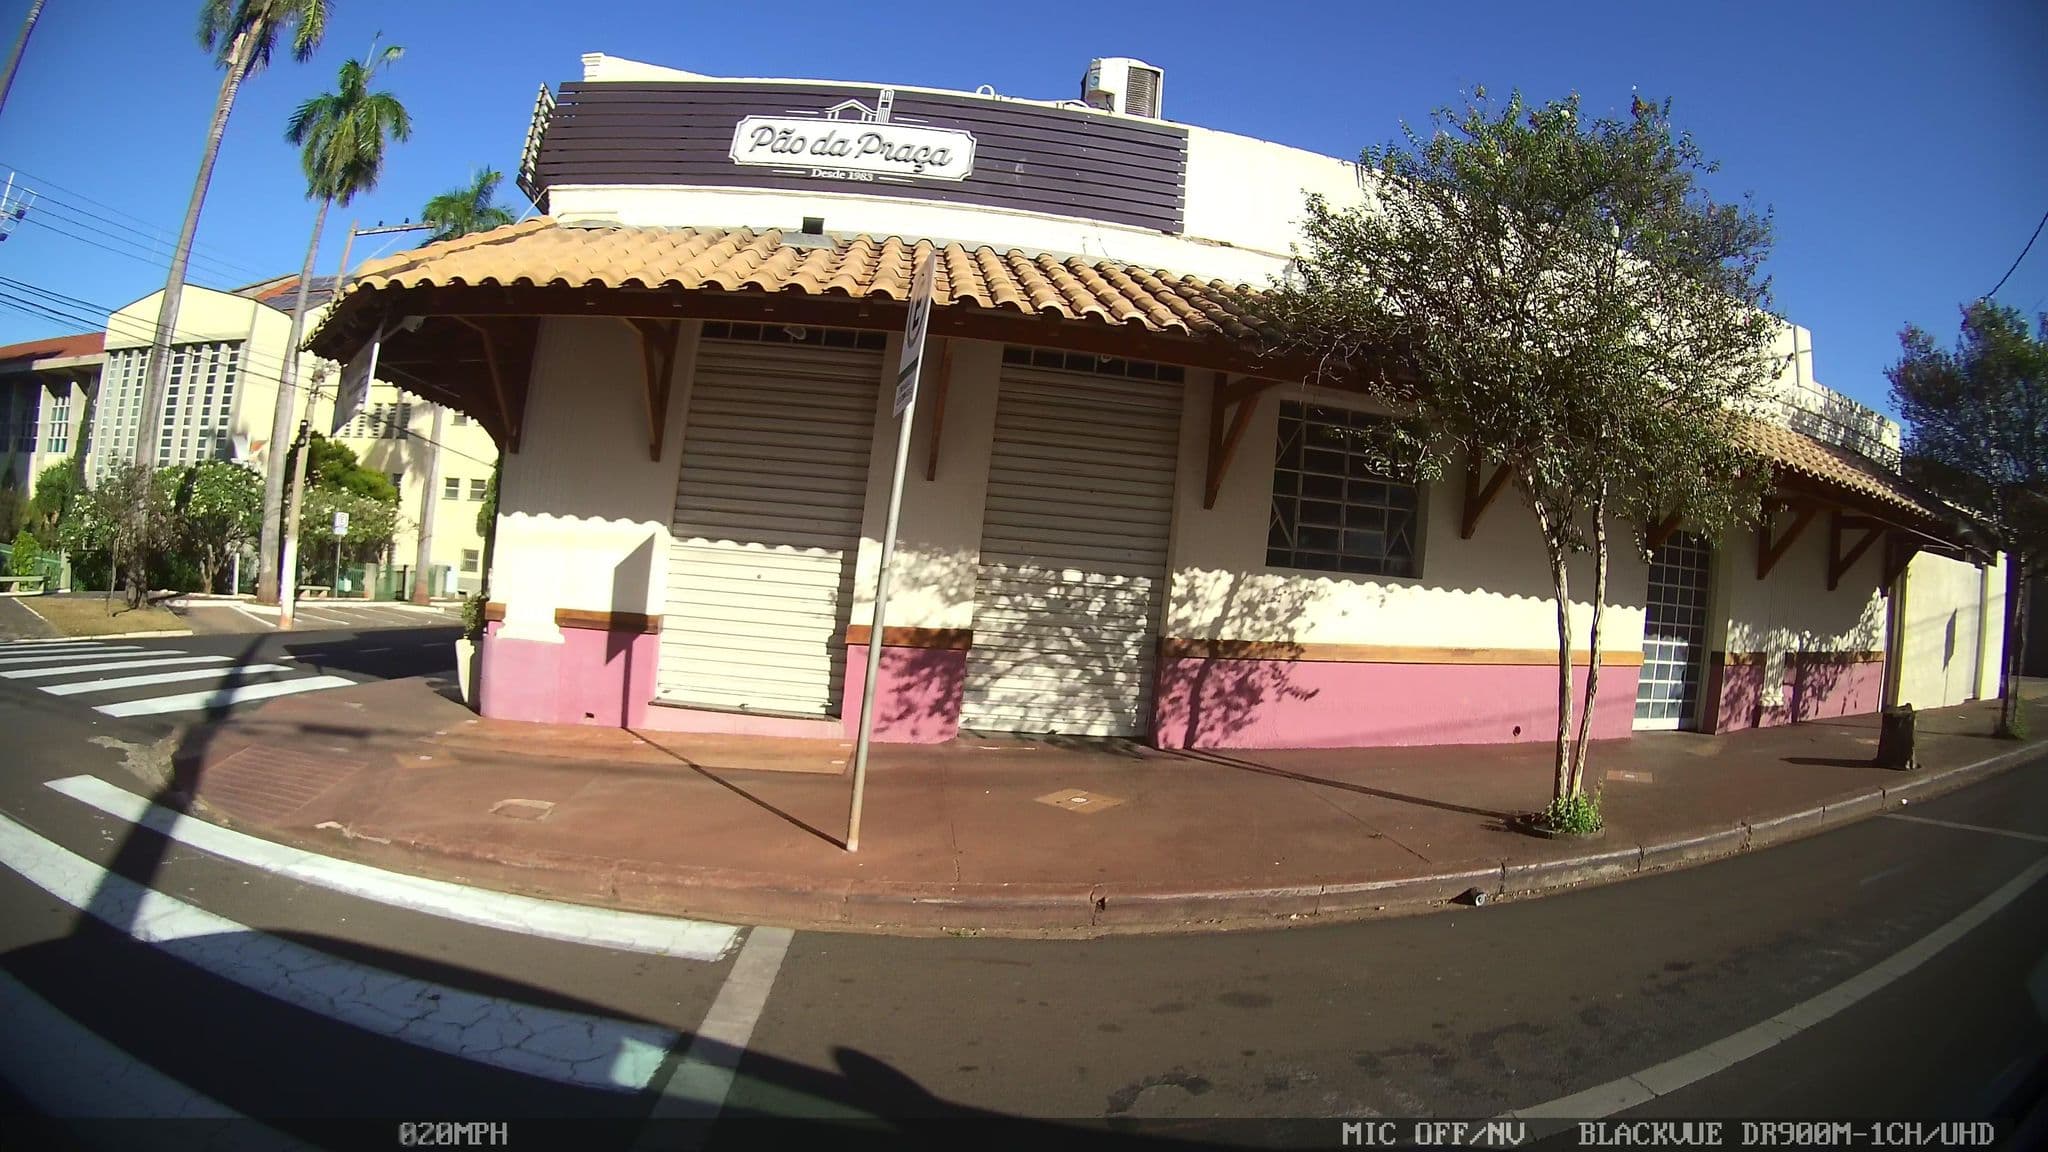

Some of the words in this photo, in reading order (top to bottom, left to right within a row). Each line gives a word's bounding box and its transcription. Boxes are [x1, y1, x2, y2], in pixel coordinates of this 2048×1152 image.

[749, 124, 806, 154] Pão
[811, 129, 853, 156] da
[854, 131, 953, 173] Praça
[812, 168, 846, 180] Desde
